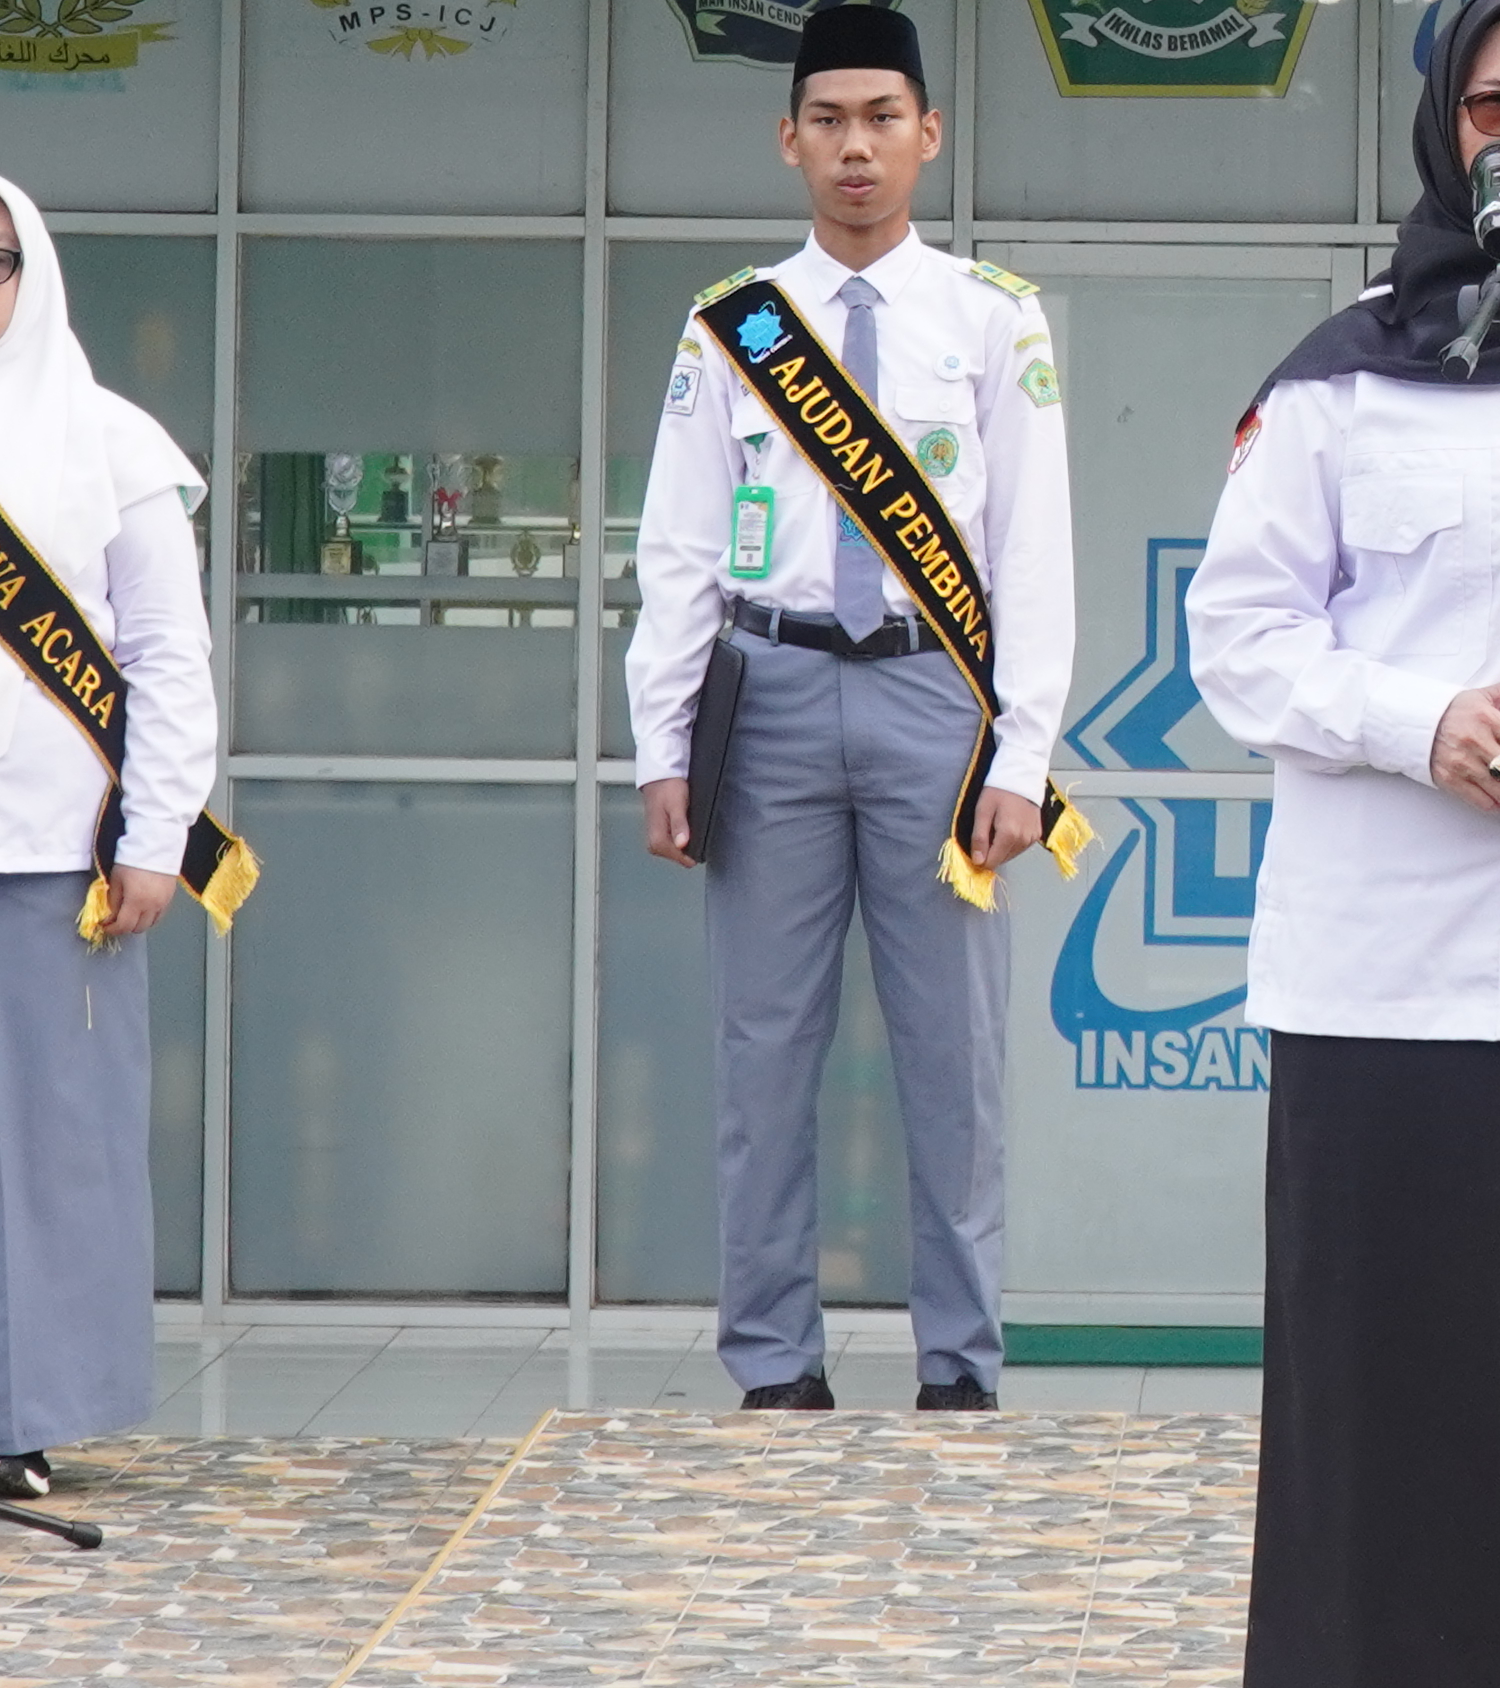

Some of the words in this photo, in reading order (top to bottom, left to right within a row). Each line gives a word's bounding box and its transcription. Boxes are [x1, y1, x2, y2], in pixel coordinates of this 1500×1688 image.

[338, 3, 496, 32] MPS-ICJ
[1105, 13, 1162, 51] IKHLAS
[1167, 14, 1244, 52] BERAMAL
[769, 355, 895, 495] AJUDAN
[880, 491, 989, 663] PEMBINA
[20, 611, 117, 730] ACARA
[1076, 1027, 1271, 1090] INSAN
